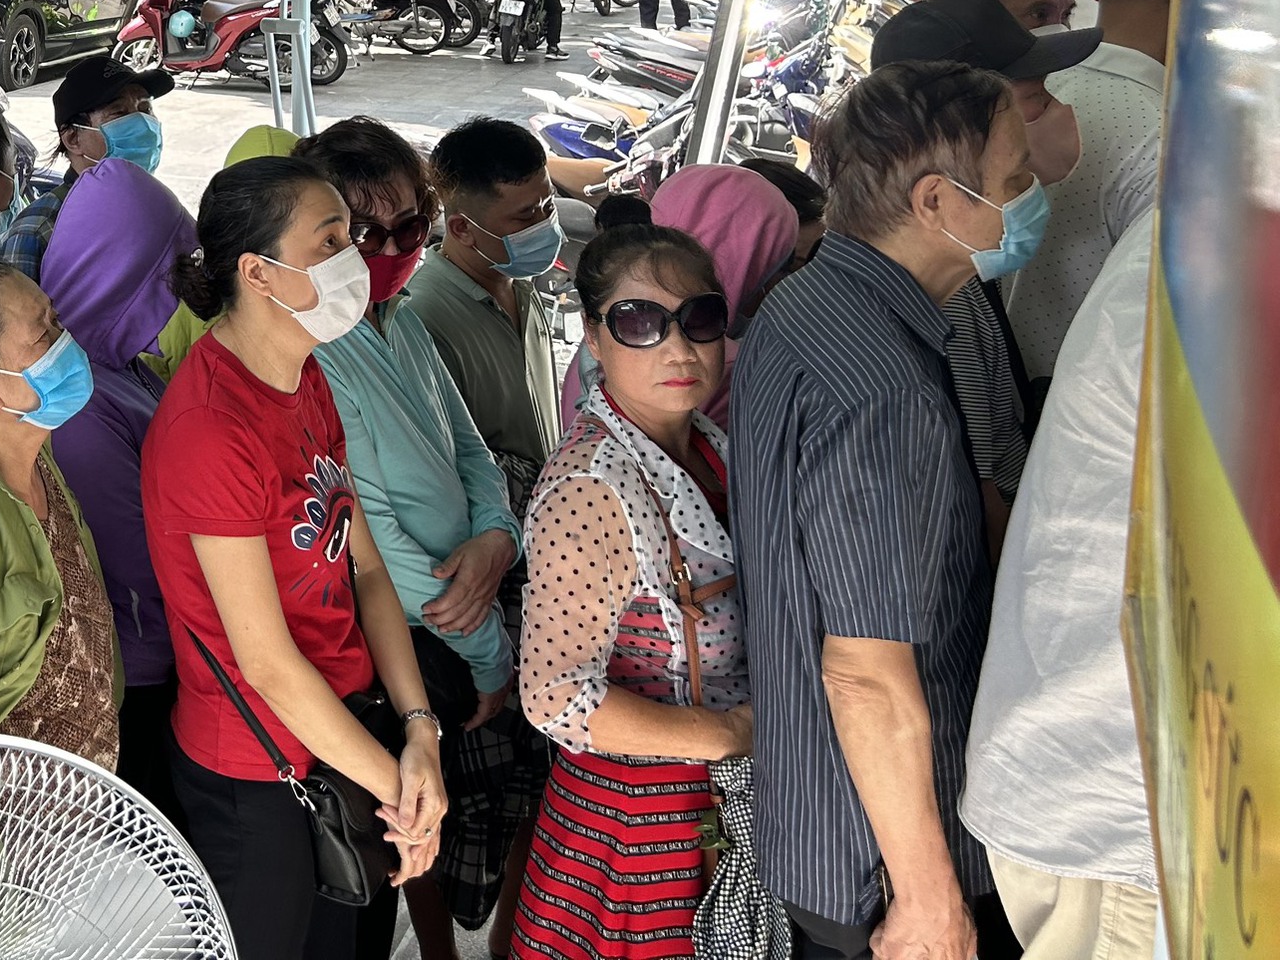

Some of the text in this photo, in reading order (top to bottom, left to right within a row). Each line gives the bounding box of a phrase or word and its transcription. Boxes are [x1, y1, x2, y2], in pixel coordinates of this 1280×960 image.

[597, 777, 610, 787] LOOK
[610, 781, 623, 792] BACK
[661, 784, 675, 792] LOOK
[676, 783, 689, 792] BACK
[576, 796, 586, 807] BACK
[606, 808, 615, 817] NOT
[685, 812, 697, 820] LOOK
[587, 829, 599, 839] BACK
[655, 844, 669, 852] LOOK
[677, 870, 690, 878] LOOK
[568, 876, 580, 887] BACK
